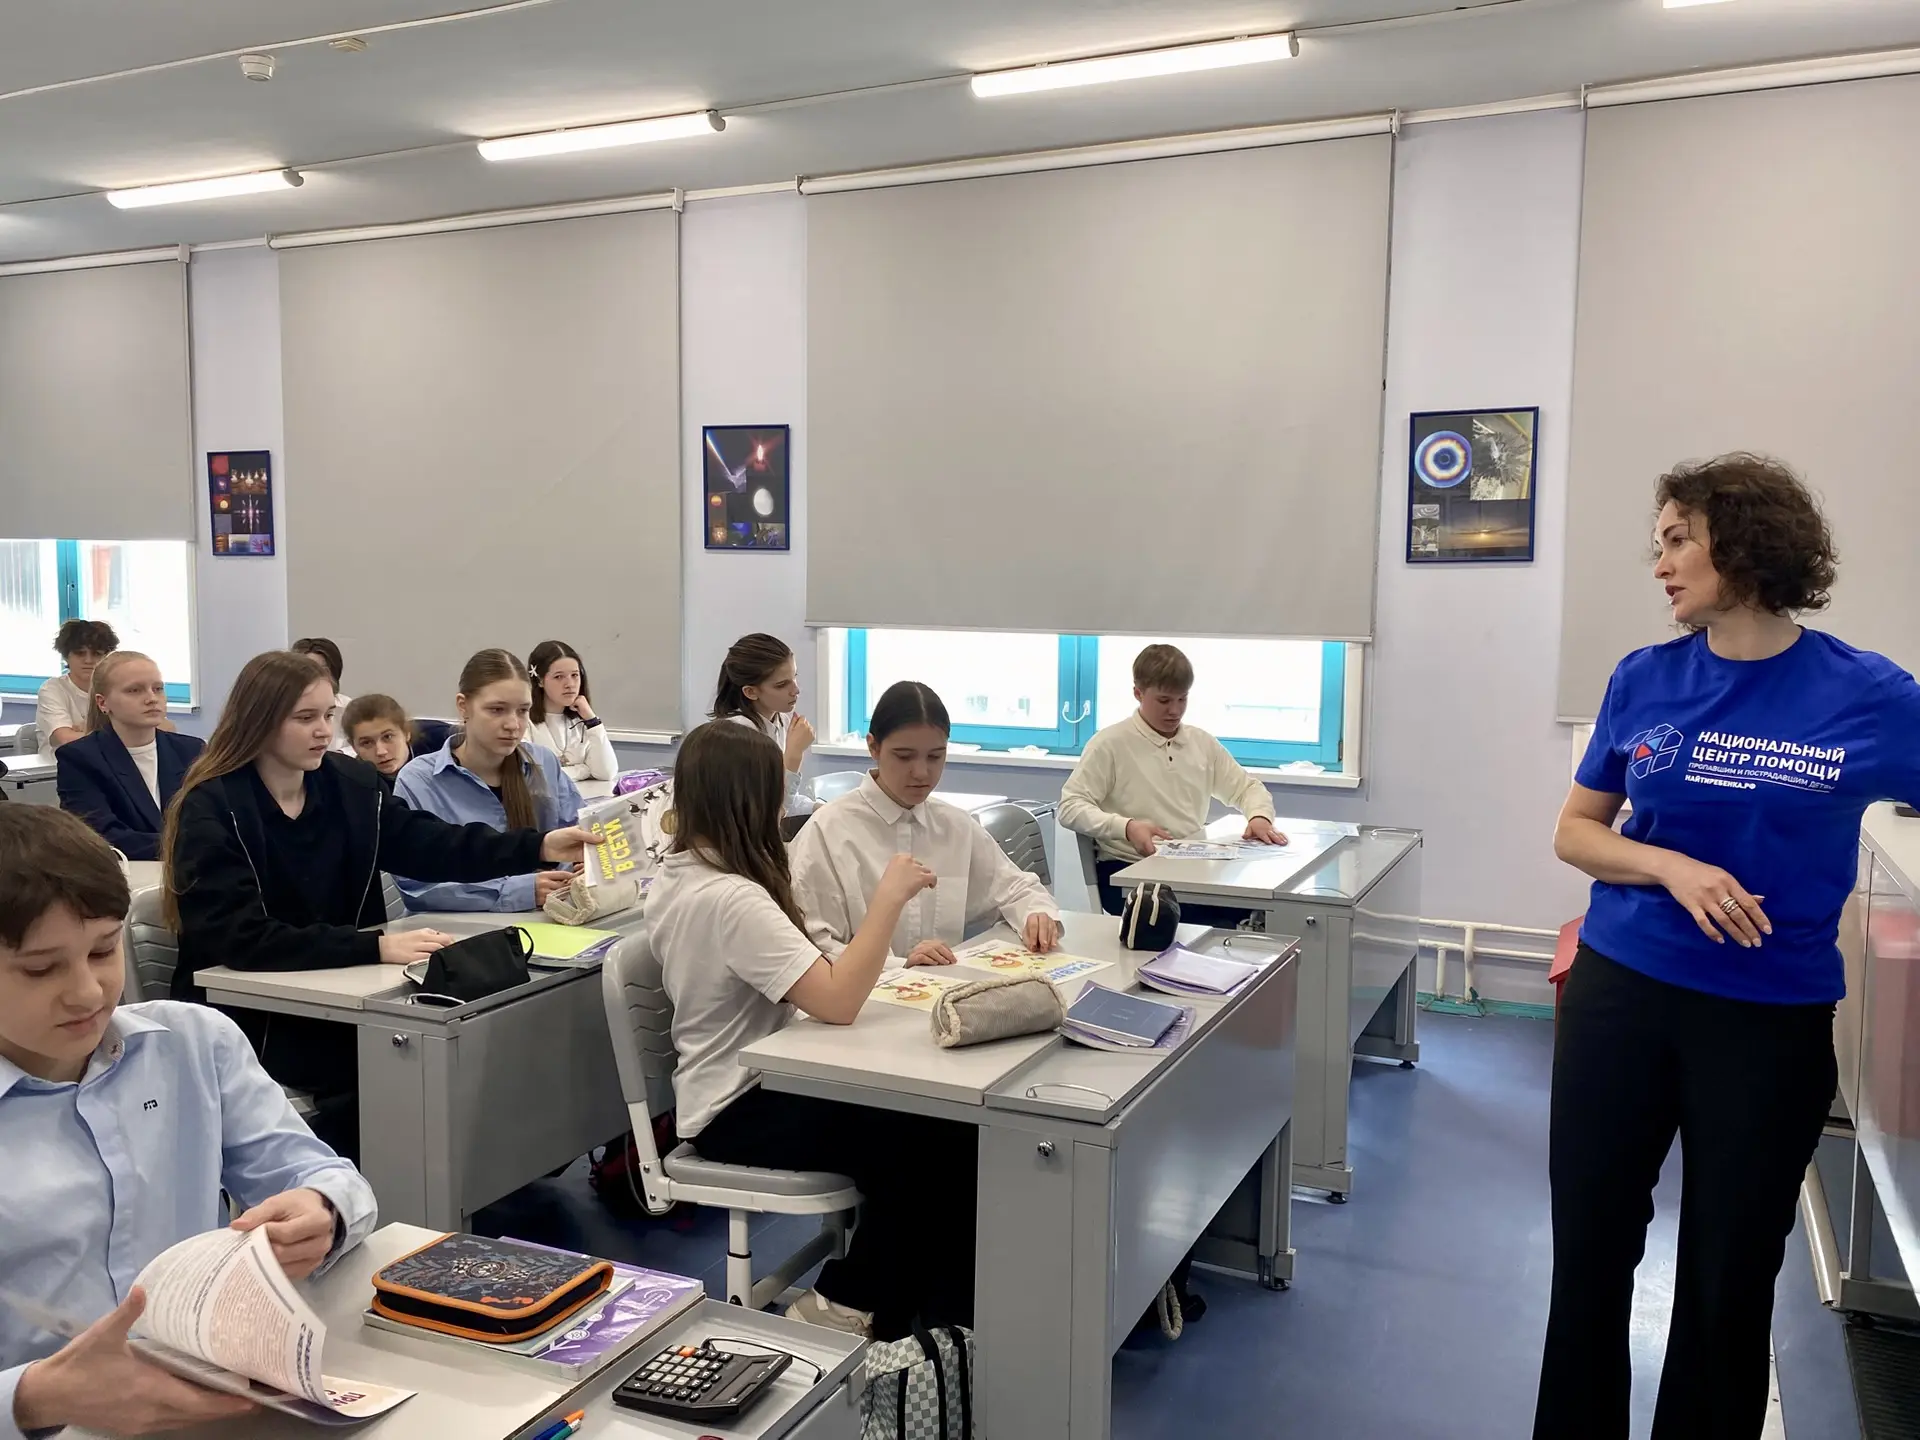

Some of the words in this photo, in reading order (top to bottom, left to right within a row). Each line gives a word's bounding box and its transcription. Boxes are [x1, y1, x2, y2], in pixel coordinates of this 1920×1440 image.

[1697, 731, 1846, 763] НАЦИОНАЛЬНЫЙ
[1688, 762, 1737, 774] ПРОПАВШИМ
[1744, 769, 1808, 786] ПОСТРАДАВШИМ
[1692, 746, 1751, 765] ЦЕНТР
[1753, 755, 1841, 781] ПОМОЩИ
[604, 818, 631, 860] СЕТИ
[615, 860, 635, 873] В
